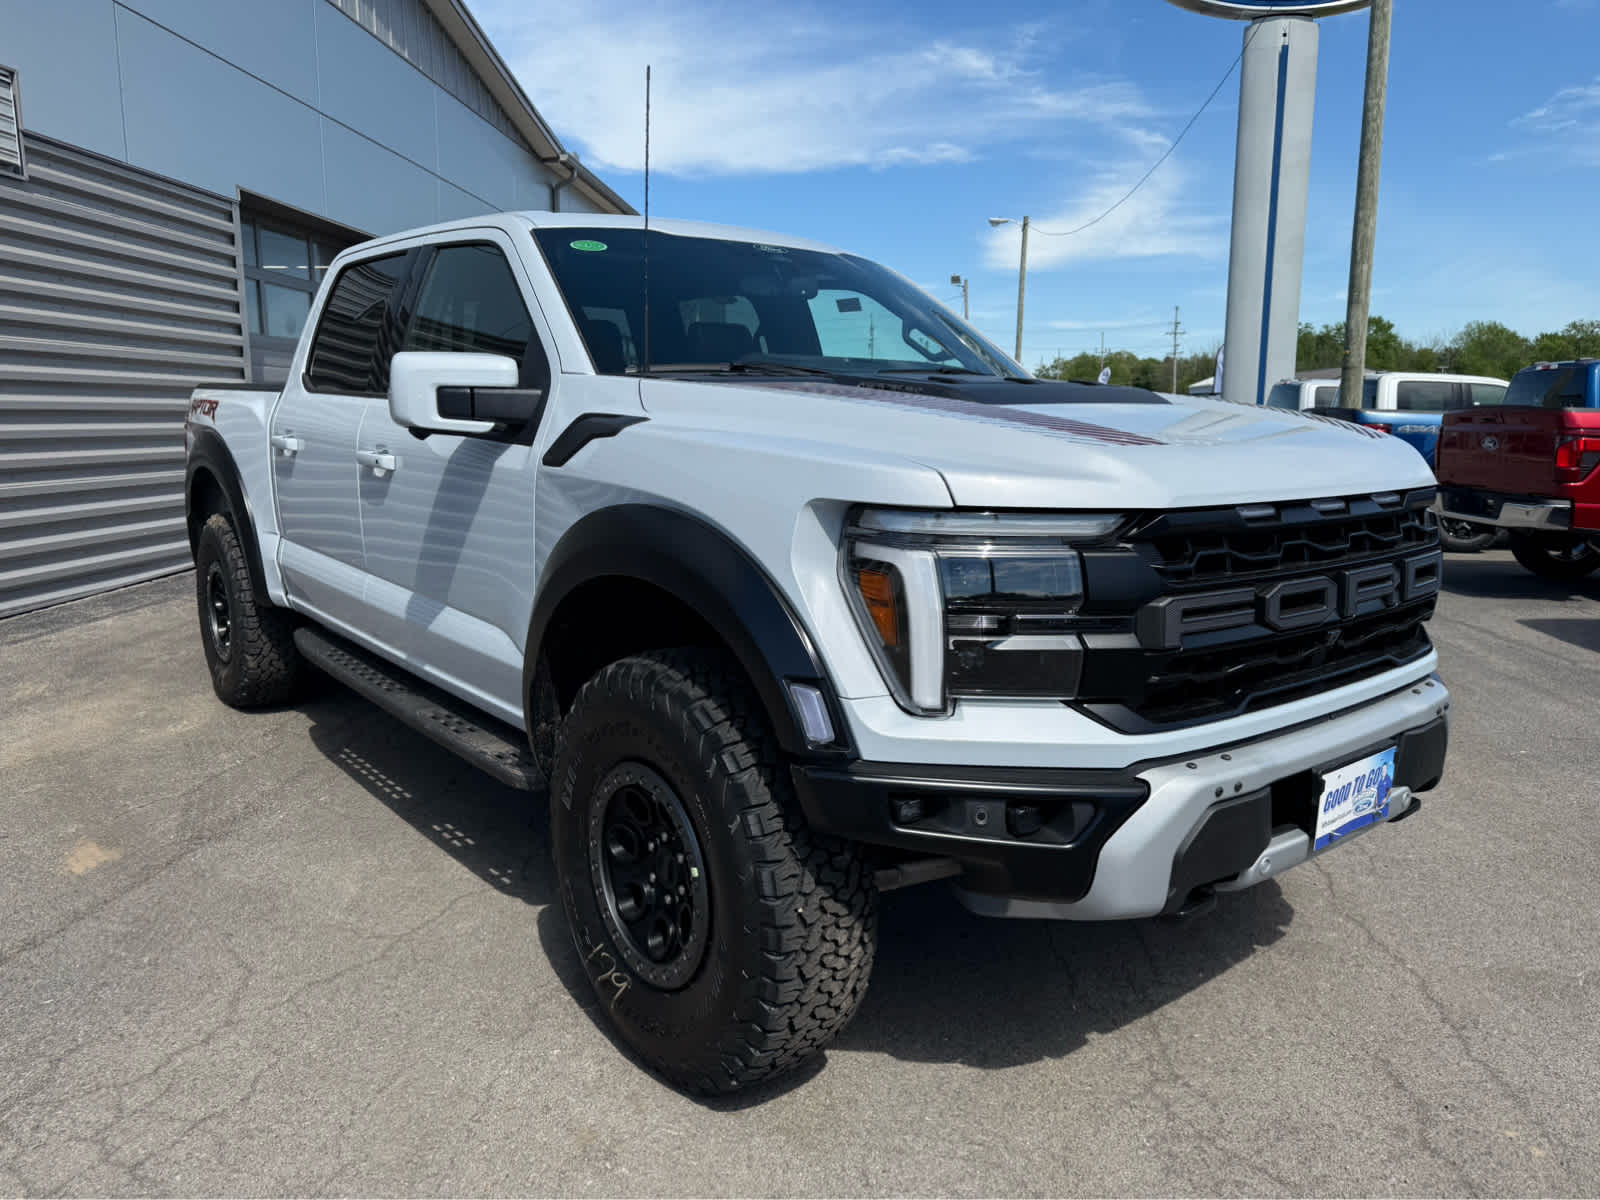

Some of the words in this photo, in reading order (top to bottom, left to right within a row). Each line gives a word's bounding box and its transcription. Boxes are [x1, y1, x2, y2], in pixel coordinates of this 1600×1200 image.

[1138, 550, 1441, 649] FORD
[1323, 782, 1352, 813] GOOD
[1352, 774, 1367, 796] TO
